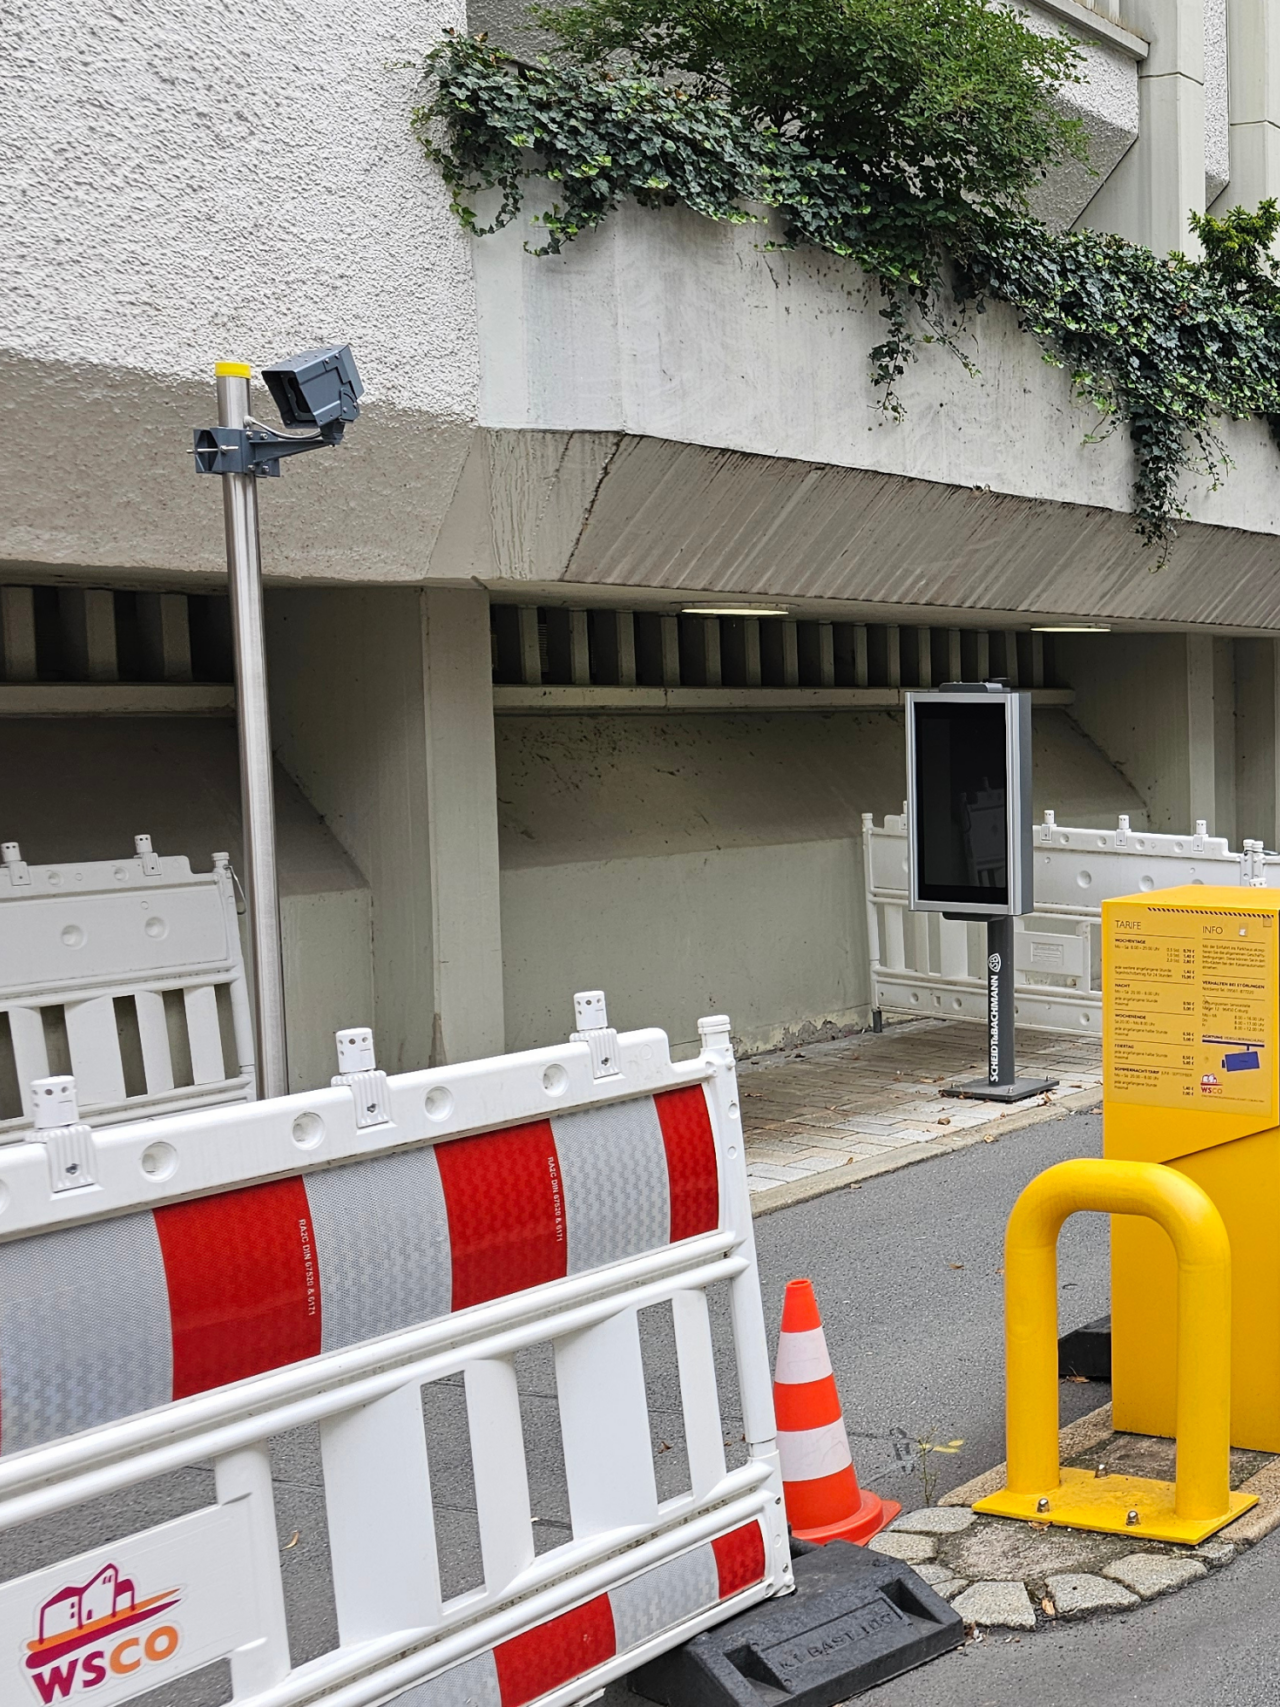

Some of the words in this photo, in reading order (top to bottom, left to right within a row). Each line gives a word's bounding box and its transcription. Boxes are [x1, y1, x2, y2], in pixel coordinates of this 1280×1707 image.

[1115, 920, 1142, 930] TARIFE
[1202, 926, 1224, 935] INFO
[1201, 1086, 1222, 1094] WSCO
[302, 1244, 312, 1260] DIN
[31, 1625, 179, 1705] WSCO
